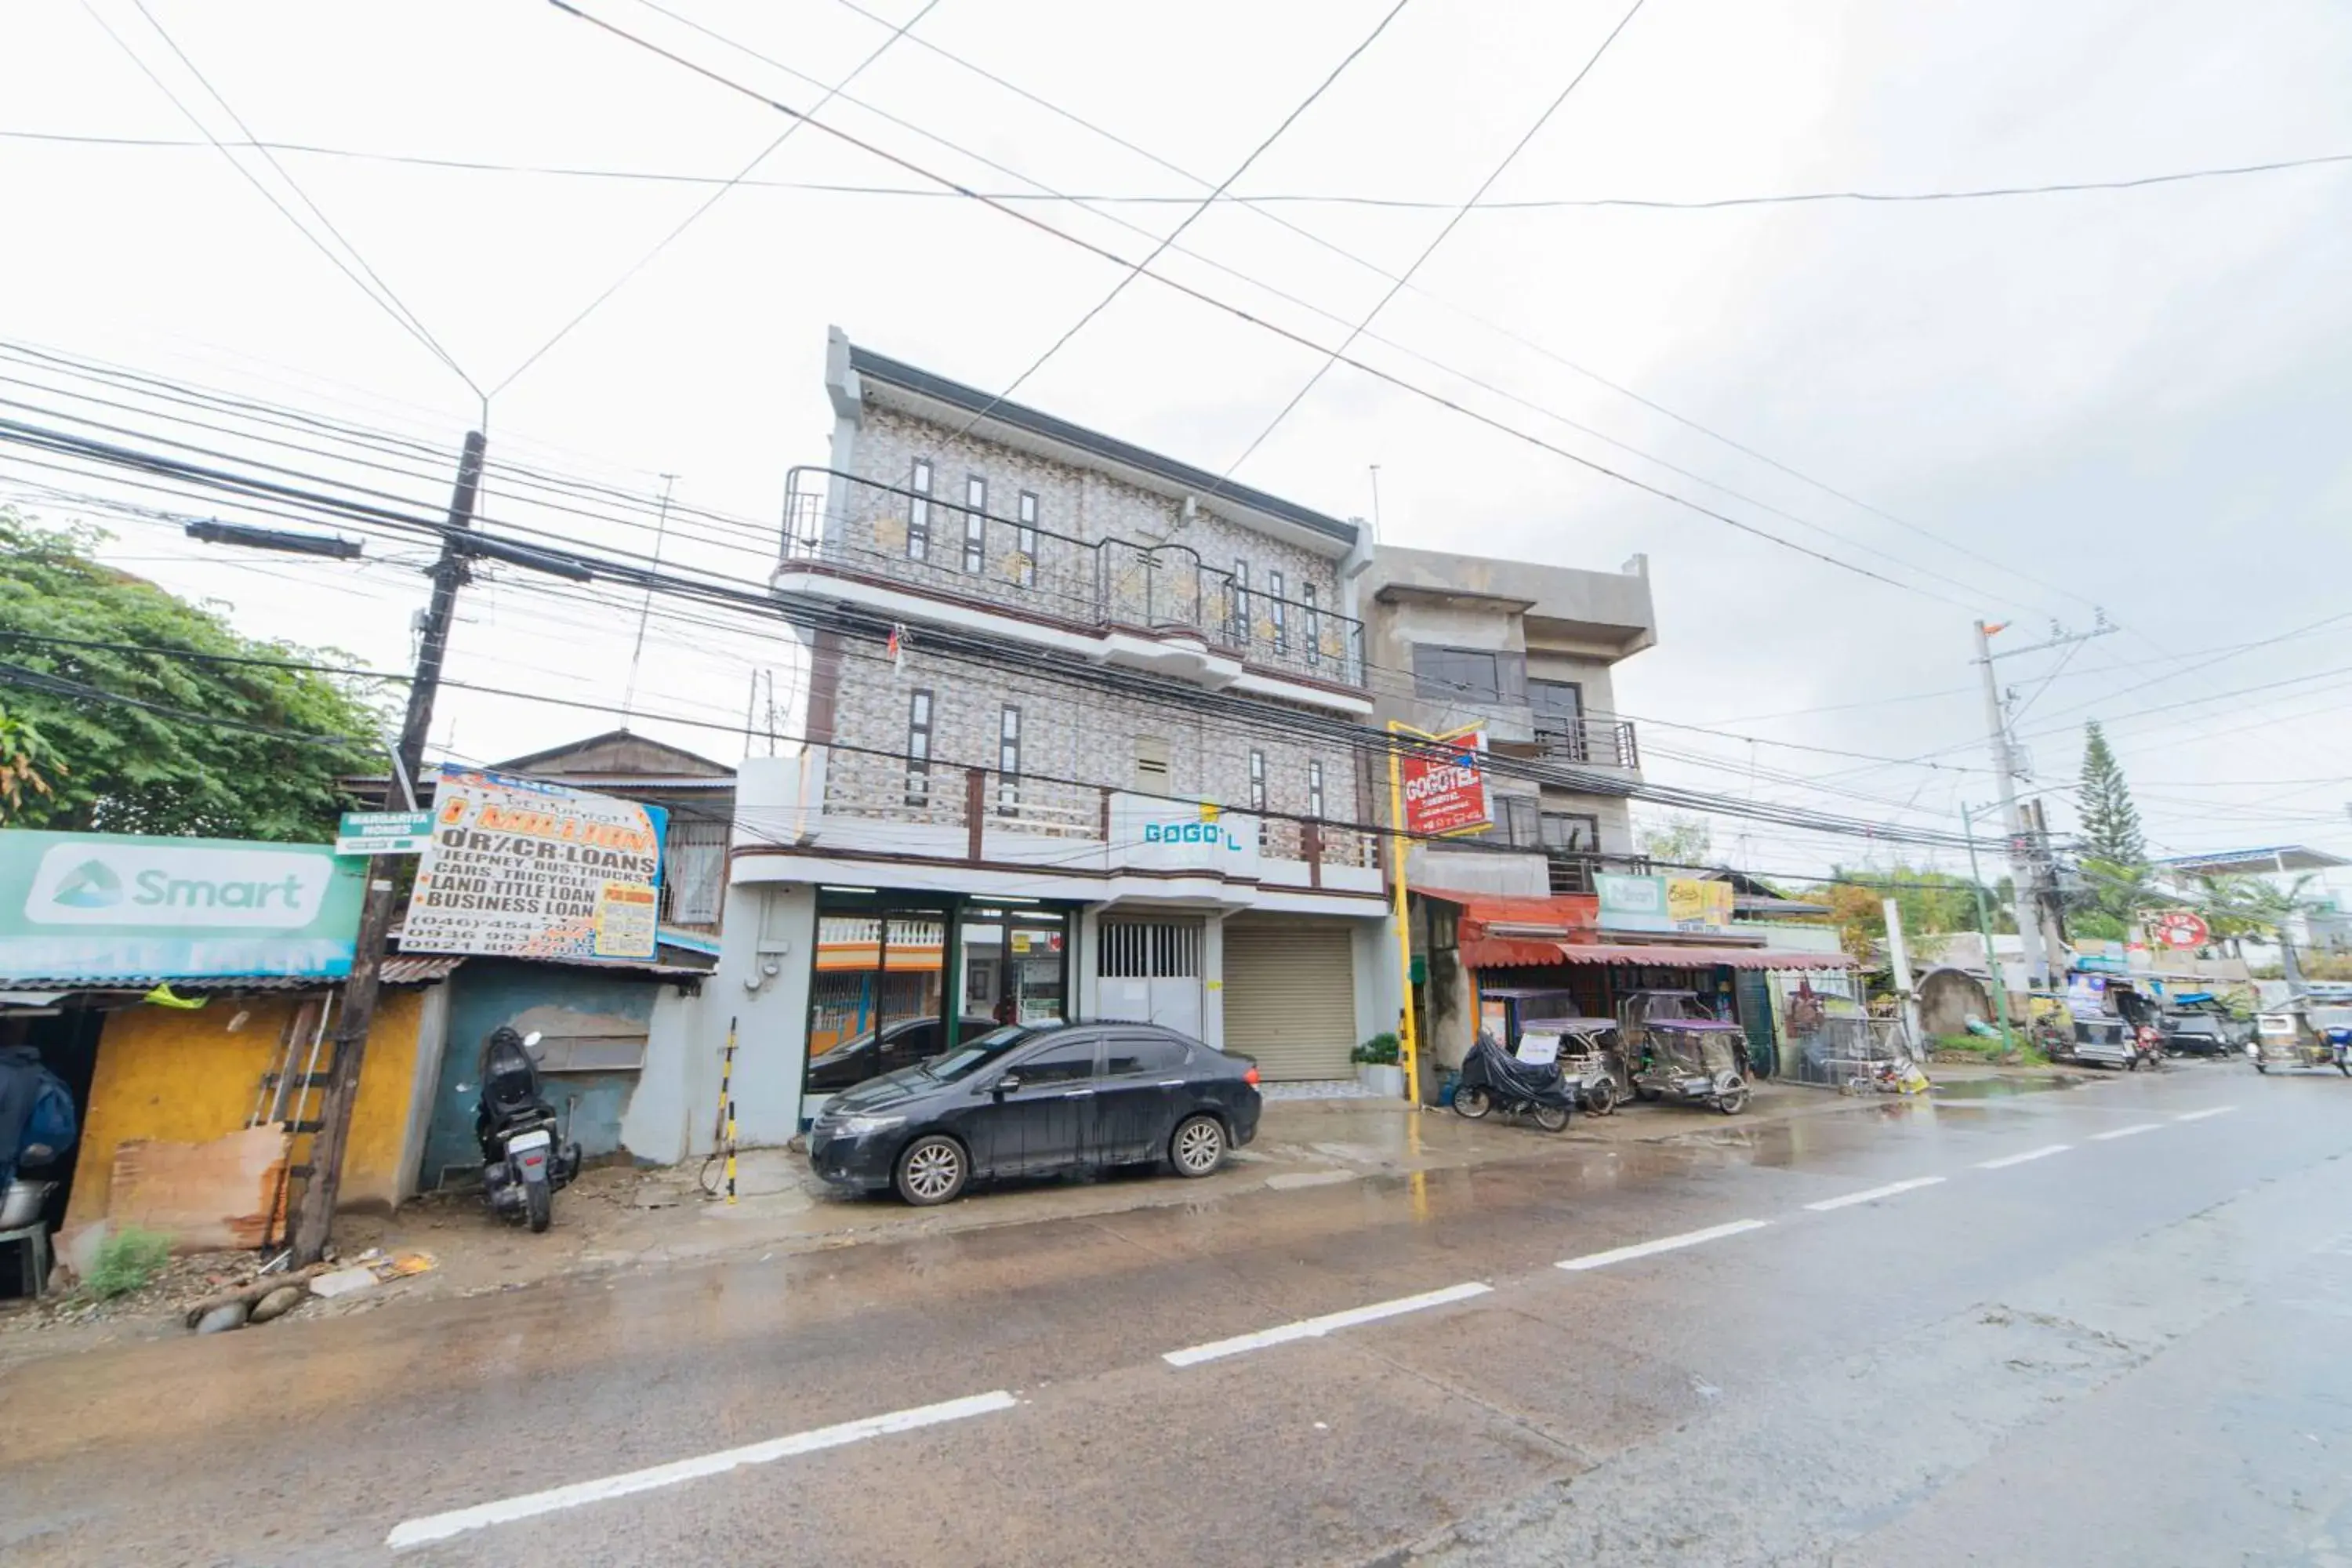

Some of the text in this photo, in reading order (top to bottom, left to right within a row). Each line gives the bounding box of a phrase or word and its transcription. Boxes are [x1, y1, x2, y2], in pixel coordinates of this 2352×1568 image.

[1406, 767, 1479, 801] GOGOTEL
[347, 814, 428, 825] MARGARITA
[567, 846, 655, 874] LOANS
[132, 869, 303, 909] Smart
[430, 874, 487, 894] LAND
[494, 880, 546, 899] TITLE
[549, 884, 596, 902] LOAN
[426, 891, 539, 913] BUSINESS
[545, 901, 595, 918] LOAN
